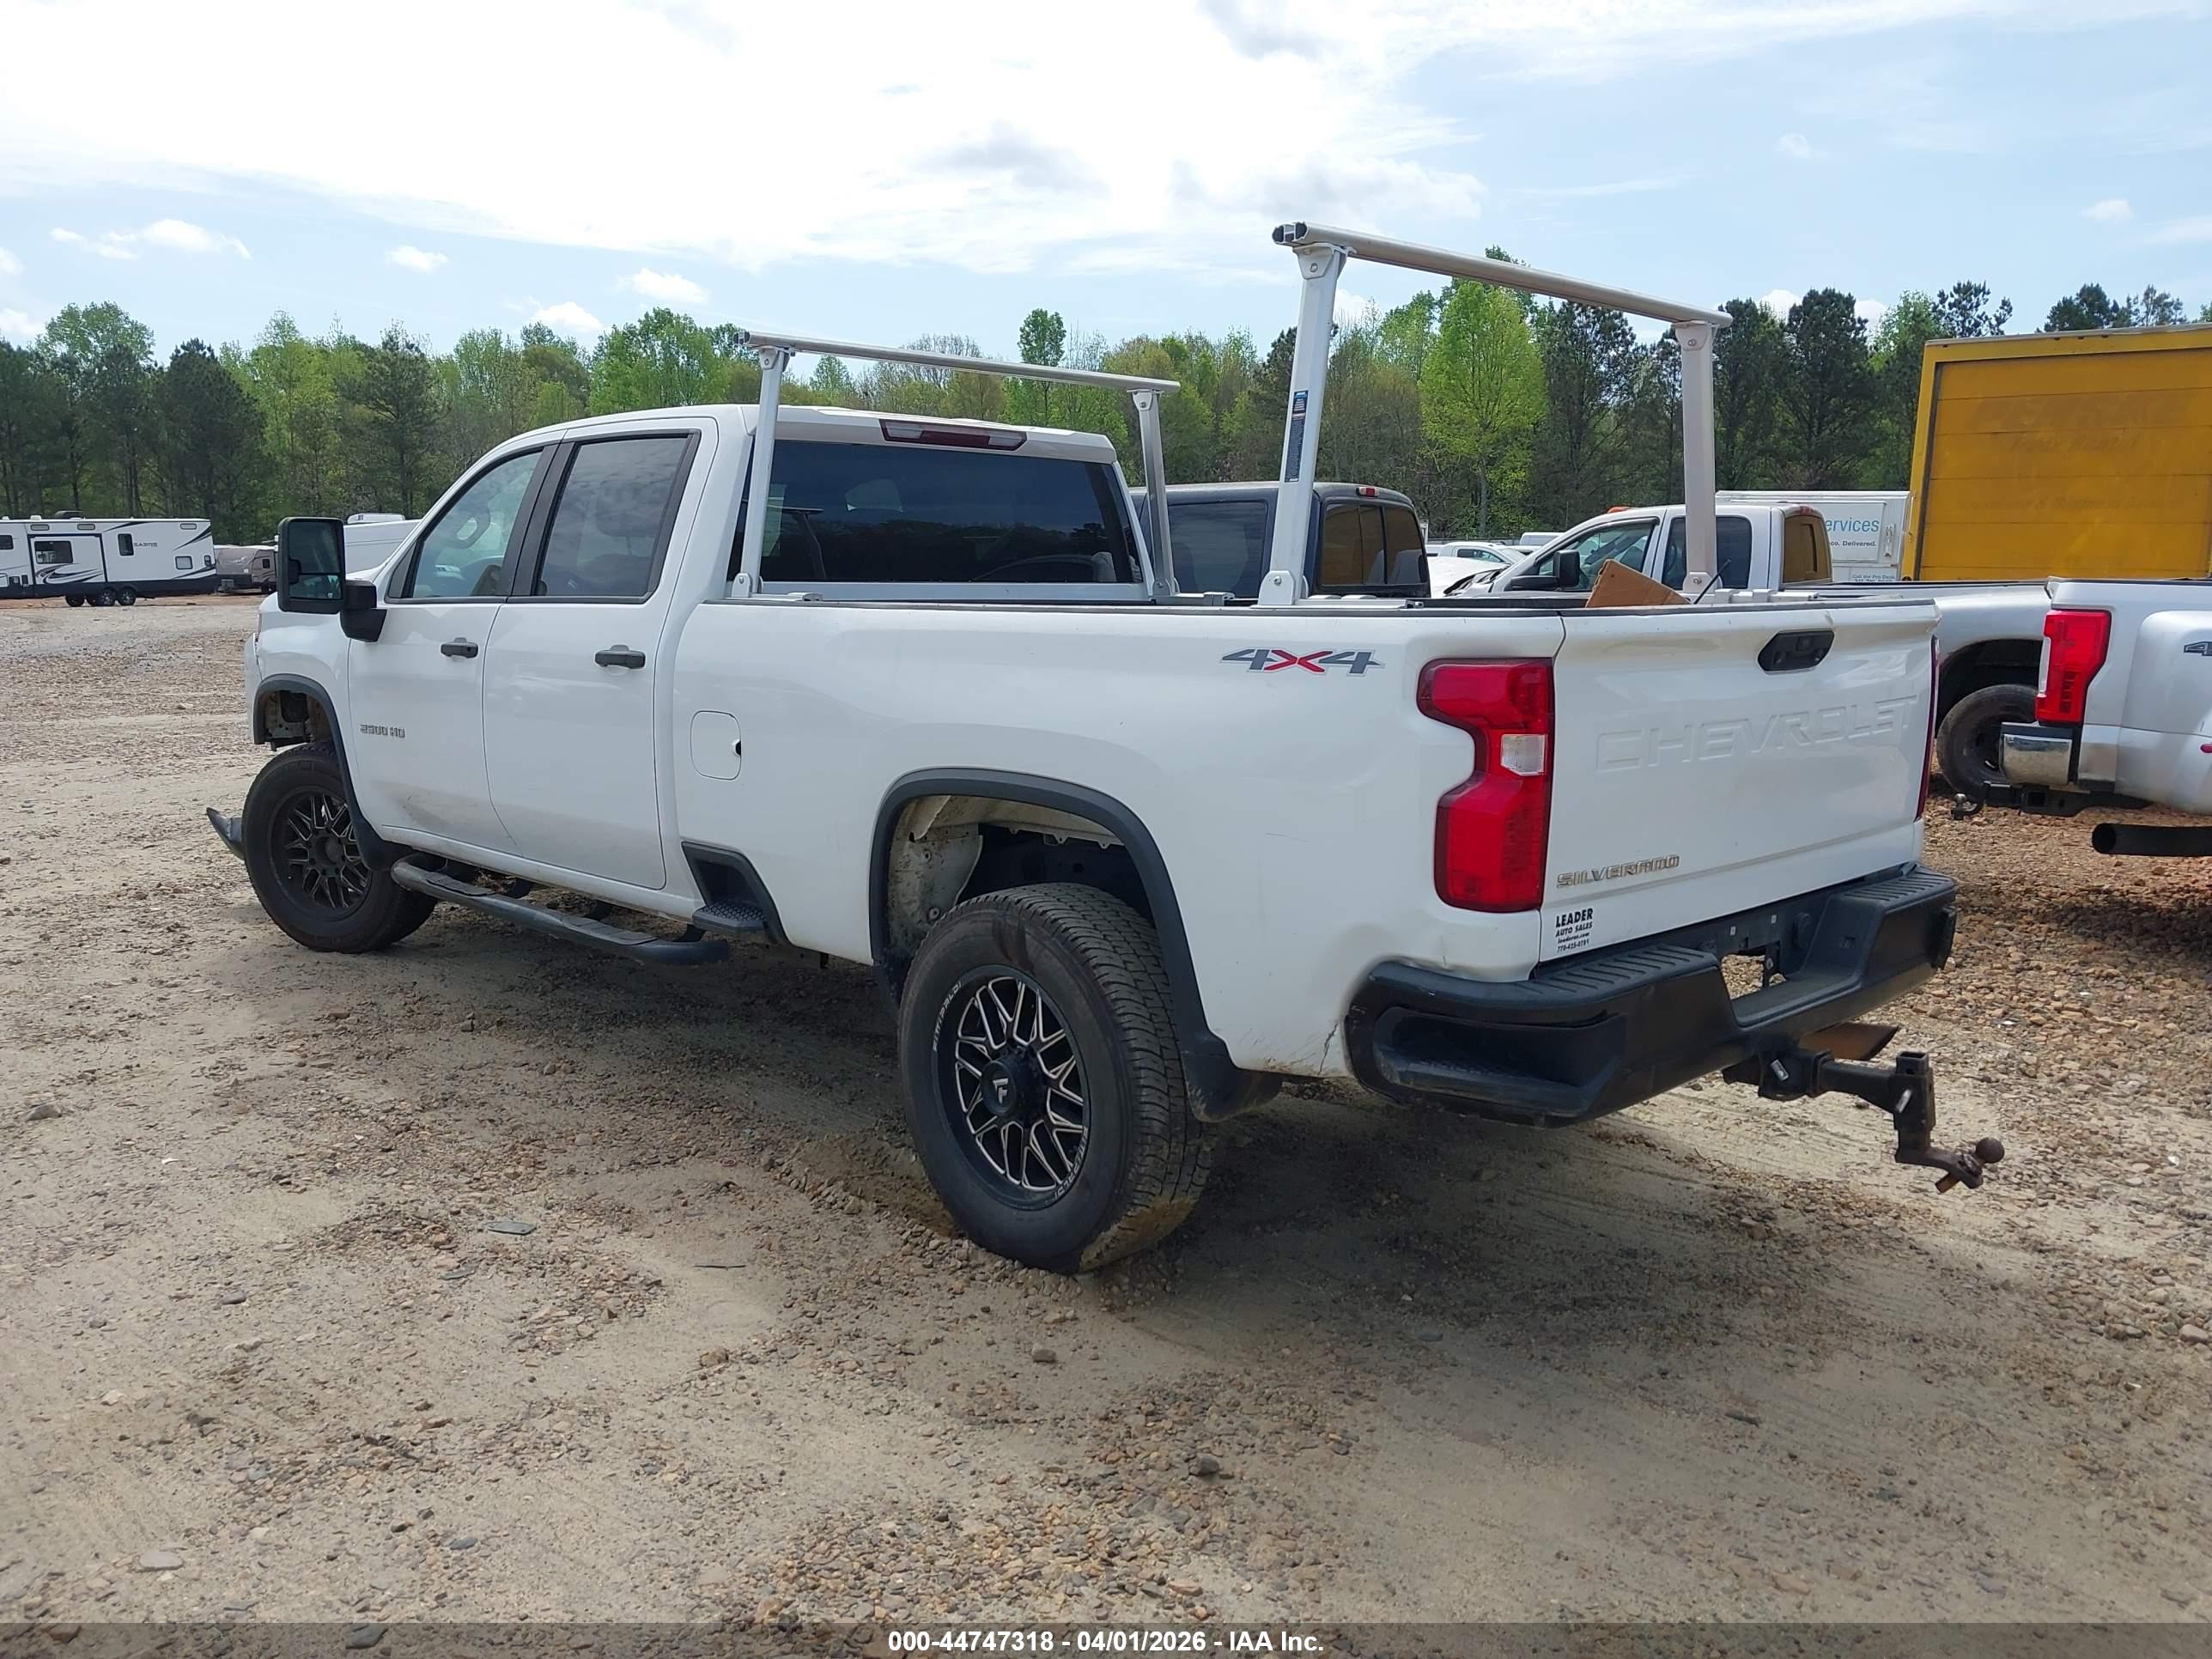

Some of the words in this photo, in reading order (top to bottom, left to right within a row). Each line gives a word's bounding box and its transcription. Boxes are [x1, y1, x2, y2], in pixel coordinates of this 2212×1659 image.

[1596, 694, 1917, 773] CHEVROLET
[1557, 854, 1680, 888] SILVERADO
[1555, 907, 1594, 928] LEADER
[1555, 927, 1573, 938] AUTO
[1575, 921, 1593, 933] SALES
